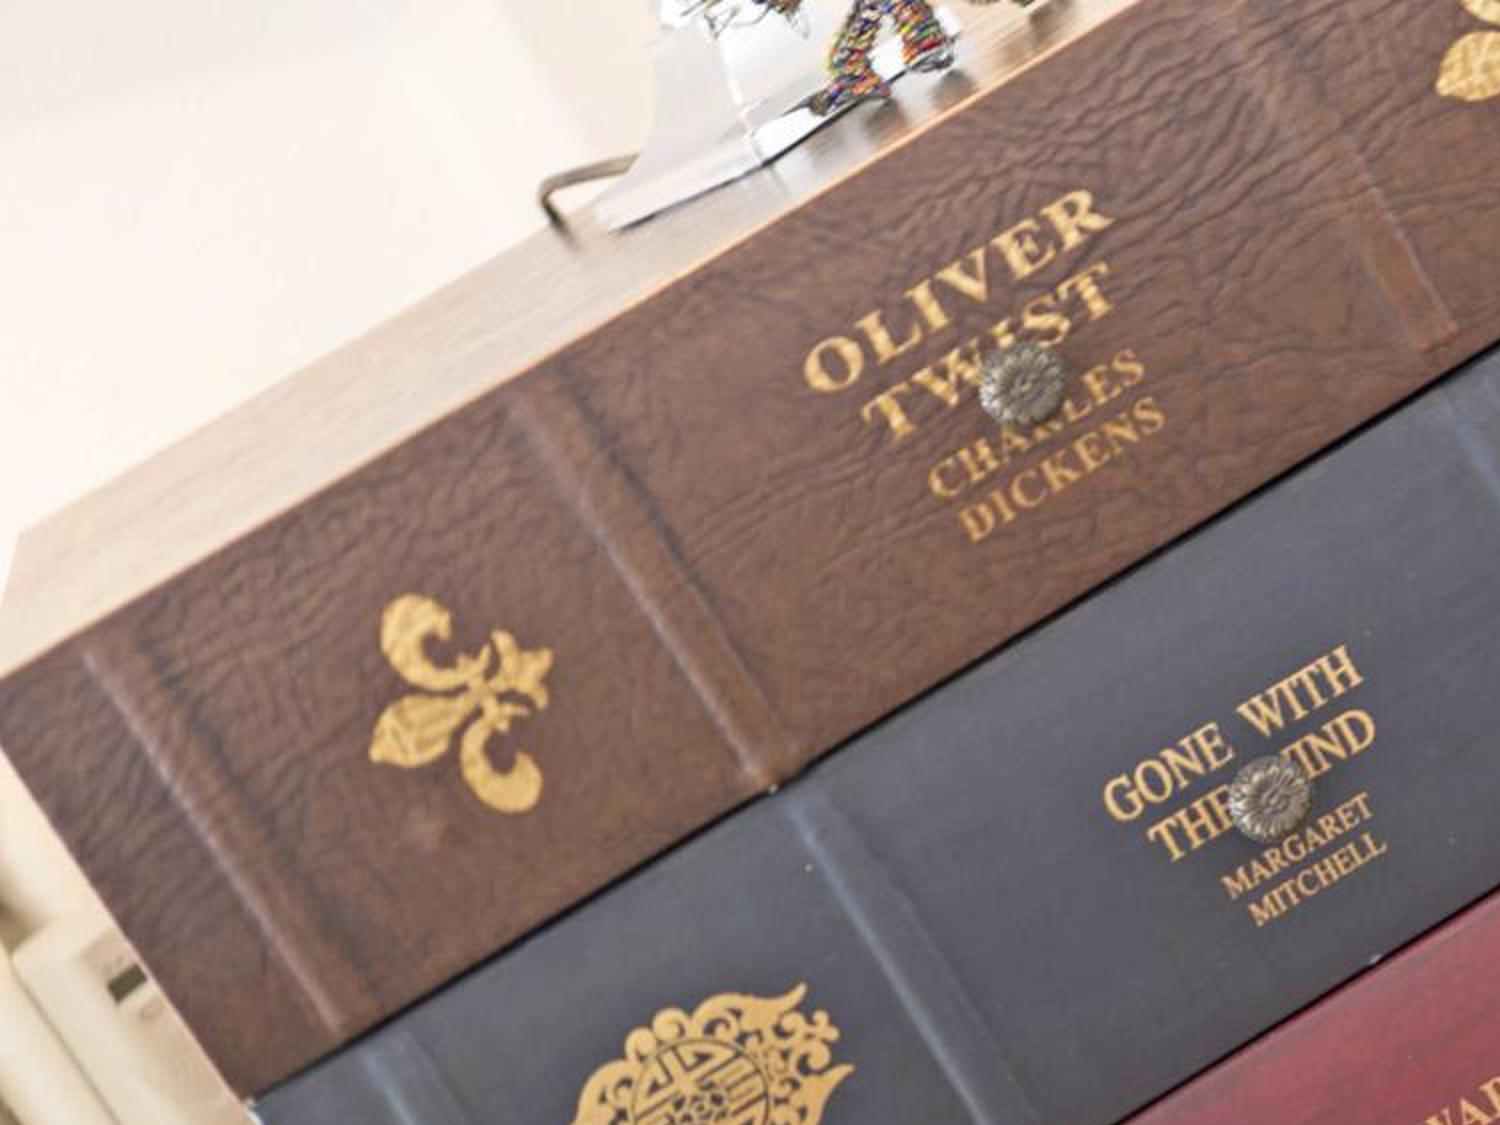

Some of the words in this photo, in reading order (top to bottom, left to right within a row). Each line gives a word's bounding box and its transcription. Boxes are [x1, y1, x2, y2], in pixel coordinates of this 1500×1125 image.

[804, 189, 1116, 394] OLIVER
[927, 349, 1145, 499] CHALES
[958, 396, 1166, 544] DICKENS
[1103, 721, 1236, 823] GONE
[1235, 644, 1364, 738] WITH
[1279, 709, 1376, 780] IND
[1220, 792, 1374, 899] MARGARET
[1248, 832, 1388, 927] MITCHELL
